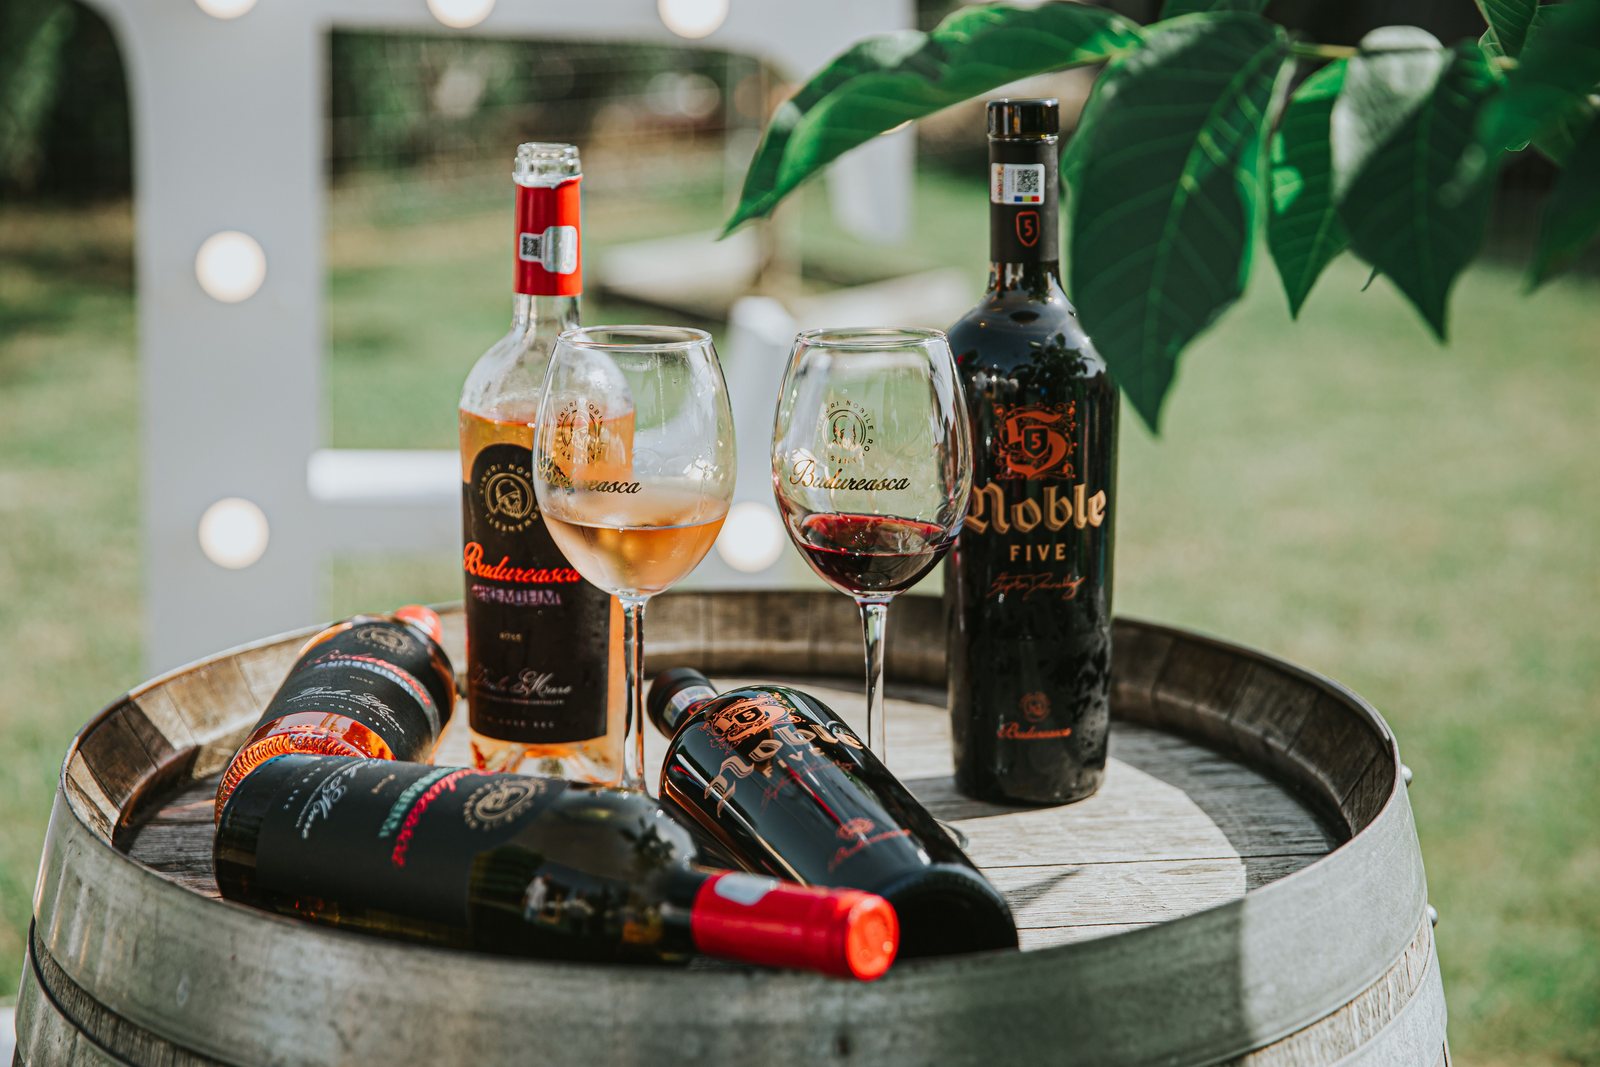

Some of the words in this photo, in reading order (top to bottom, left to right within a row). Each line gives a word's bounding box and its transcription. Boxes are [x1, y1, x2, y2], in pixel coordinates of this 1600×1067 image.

[1024, 219, 1033, 237] 5
[1031, 433, 1041, 449] 5
[789, 459, 910, 491] Budureasca
[964, 481, 1107, 534] Noble
[464, 541, 581, 584] Budureasca
[1009, 543, 1066, 562] FIVE
[742, 709, 757, 721] 5
[703, 723, 864, 819] Noble
[762, 747, 825, 779] FIVE
